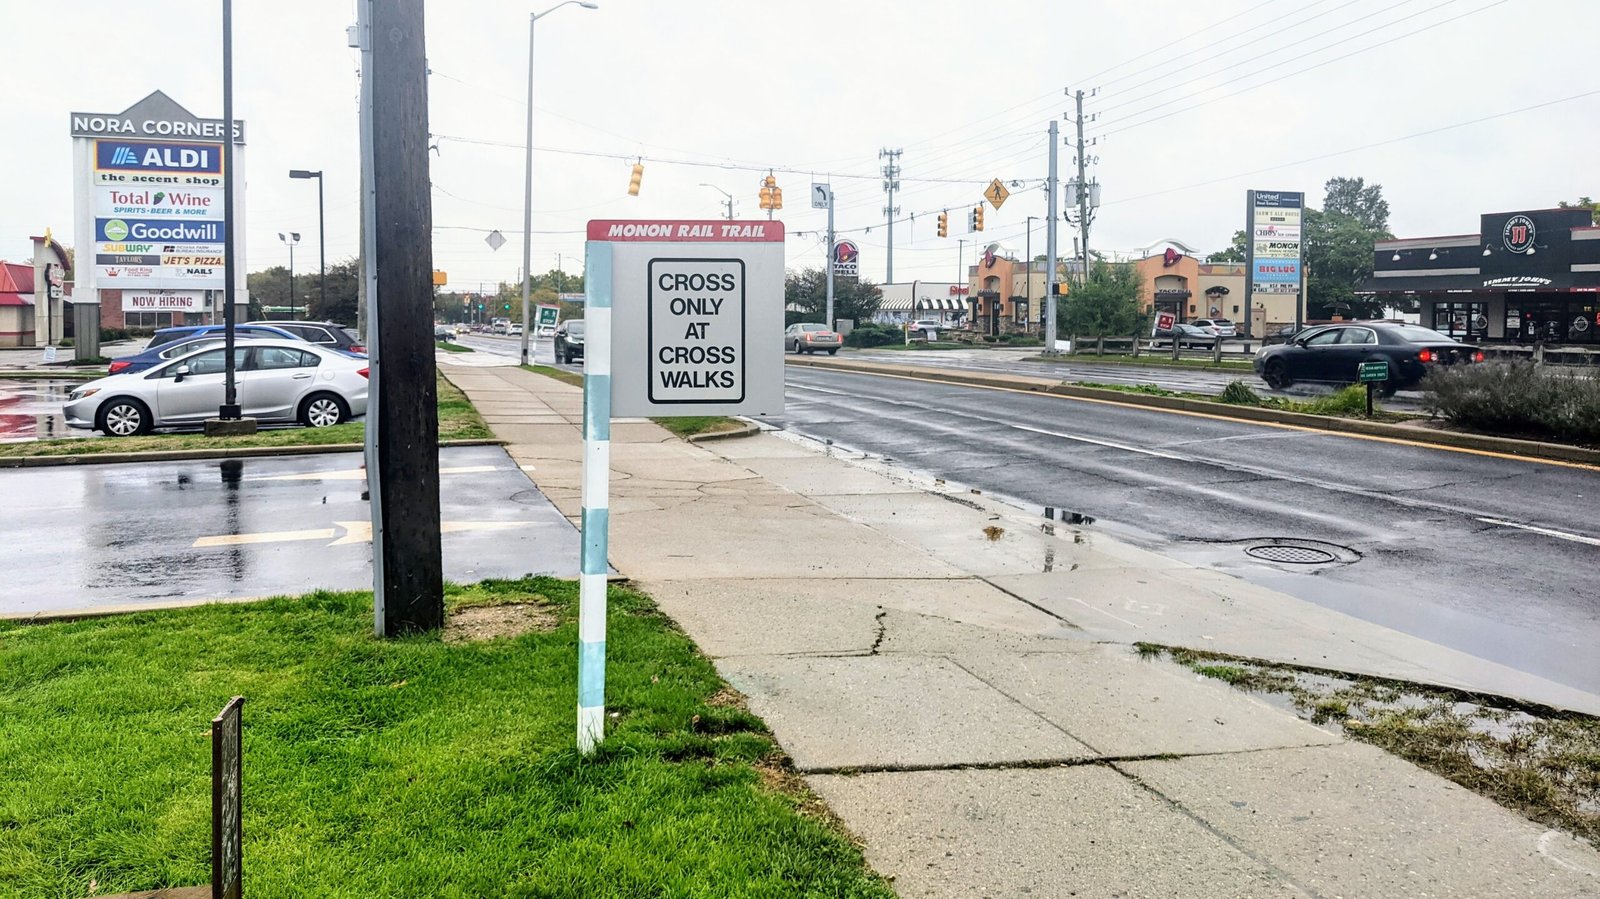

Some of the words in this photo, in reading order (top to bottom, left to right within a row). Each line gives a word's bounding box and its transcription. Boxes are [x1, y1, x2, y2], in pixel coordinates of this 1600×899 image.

[74, 117, 136, 133] NORA
[142, 121, 240, 138] CORNERS
[142, 148, 208, 168] ALDI
[101, 174, 126, 182] the
[186, 176, 220, 186] shop
[110, 191, 148, 205] Total
[169, 193, 211, 206] Wine
[132, 223, 217, 240] Goodwill
[608, 224, 672, 238] MONON
[678, 225, 714, 238] RAIL
[722, 225, 765, 238] TRAIL
[1505, 218, 1518, 235] JIMMY
[1512, 225, 1526, 244] JJ
[102, 244, 153, 252] SUBWAY
[164, 256, 190, 264] JET'S
[658, 274, 736, 292] CROSS
[1483, 276, 1518, 287] JIMMY
[1519, 276, 1552, 285] JOHN'S
[132, 296, 156, 306] NOW
[160, 296, 192, 307] HIRING
[670, 298, 724, 316] ONLY
[684, 322, 710, 340] AT
[658, 346, 736, 364] CROSS
[660, 370, 734, 388] WALKS
